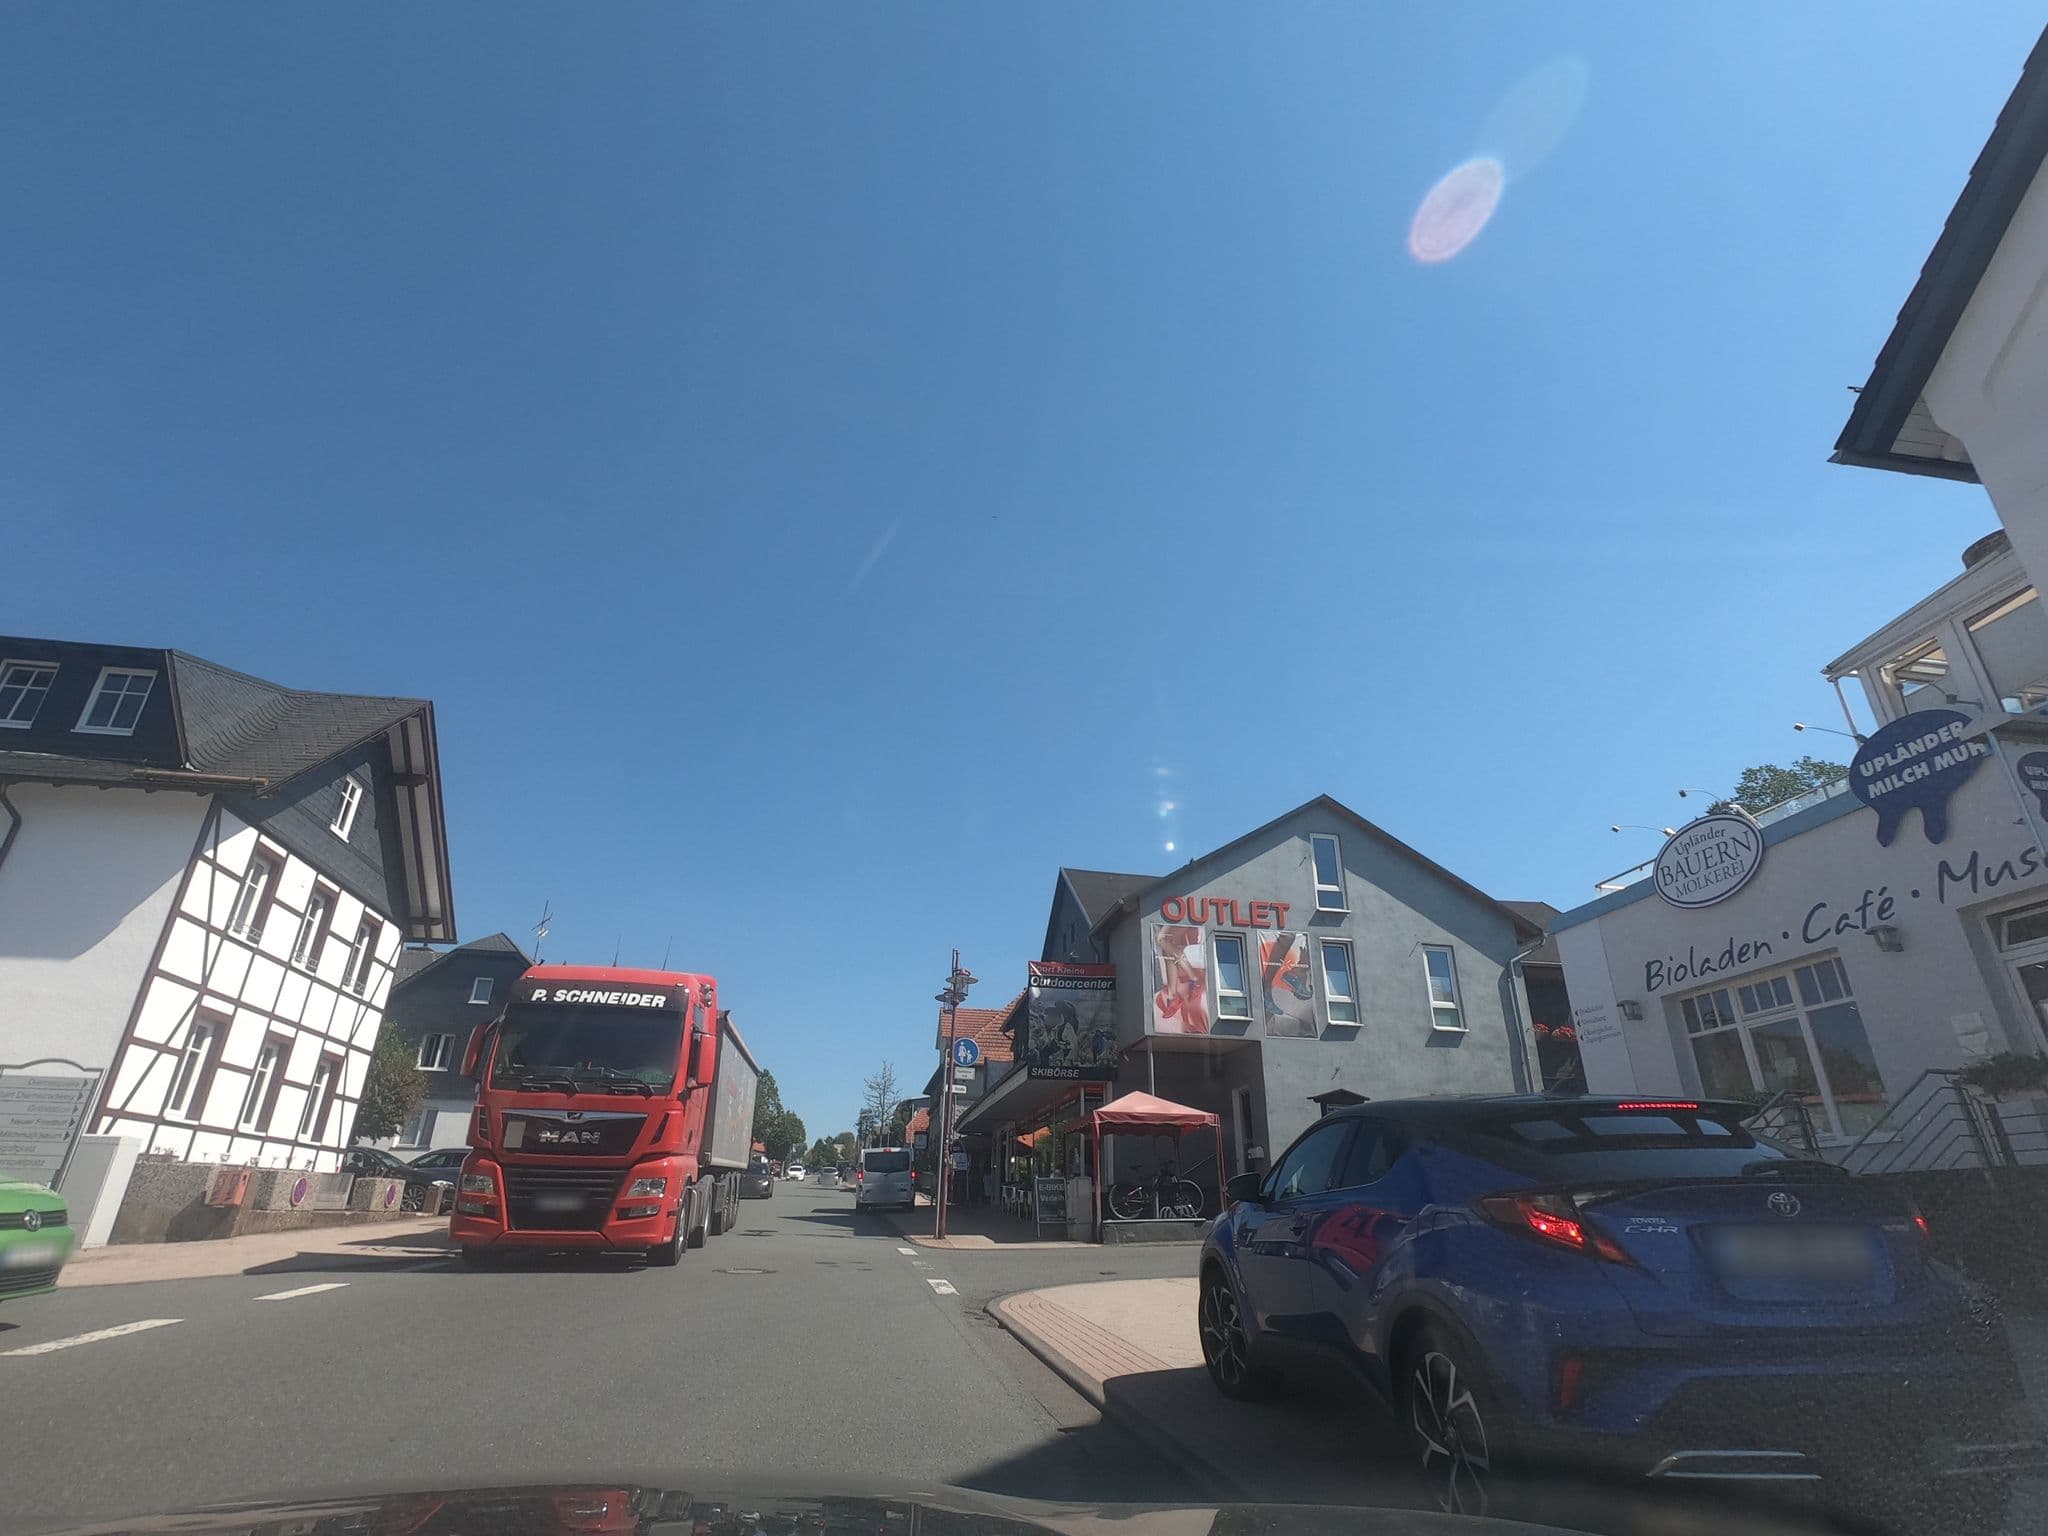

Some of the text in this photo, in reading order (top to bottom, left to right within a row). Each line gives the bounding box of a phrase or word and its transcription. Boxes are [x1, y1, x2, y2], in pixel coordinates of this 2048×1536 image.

[1859, 720, 1964, 777] UPLÄNDER
[1867, 761, 1931, 799] MILCH
[1674, 827, 1726, 856] Upländer
[1660, 830, 1753, 886] BAUERN
[1675, 860, 1746, 898] MOLKEREI
[1161, 895, 1290, 928] OUTLET
[1644, 846, 2048, 993] Bioladen Café Mus
[1030, 976, 1113, 989] Outdoorcenter
[531, 988, 667, 1008] P. SCHNEIDER
[1031, 1066, 1080, 1078] SKIBÖRSE
[538, 1130, 601, 1145] MAN
[1624, 1225, 1679, 1234] C-HR
[1630, 1216, 1668, 1225] TOYOTA
